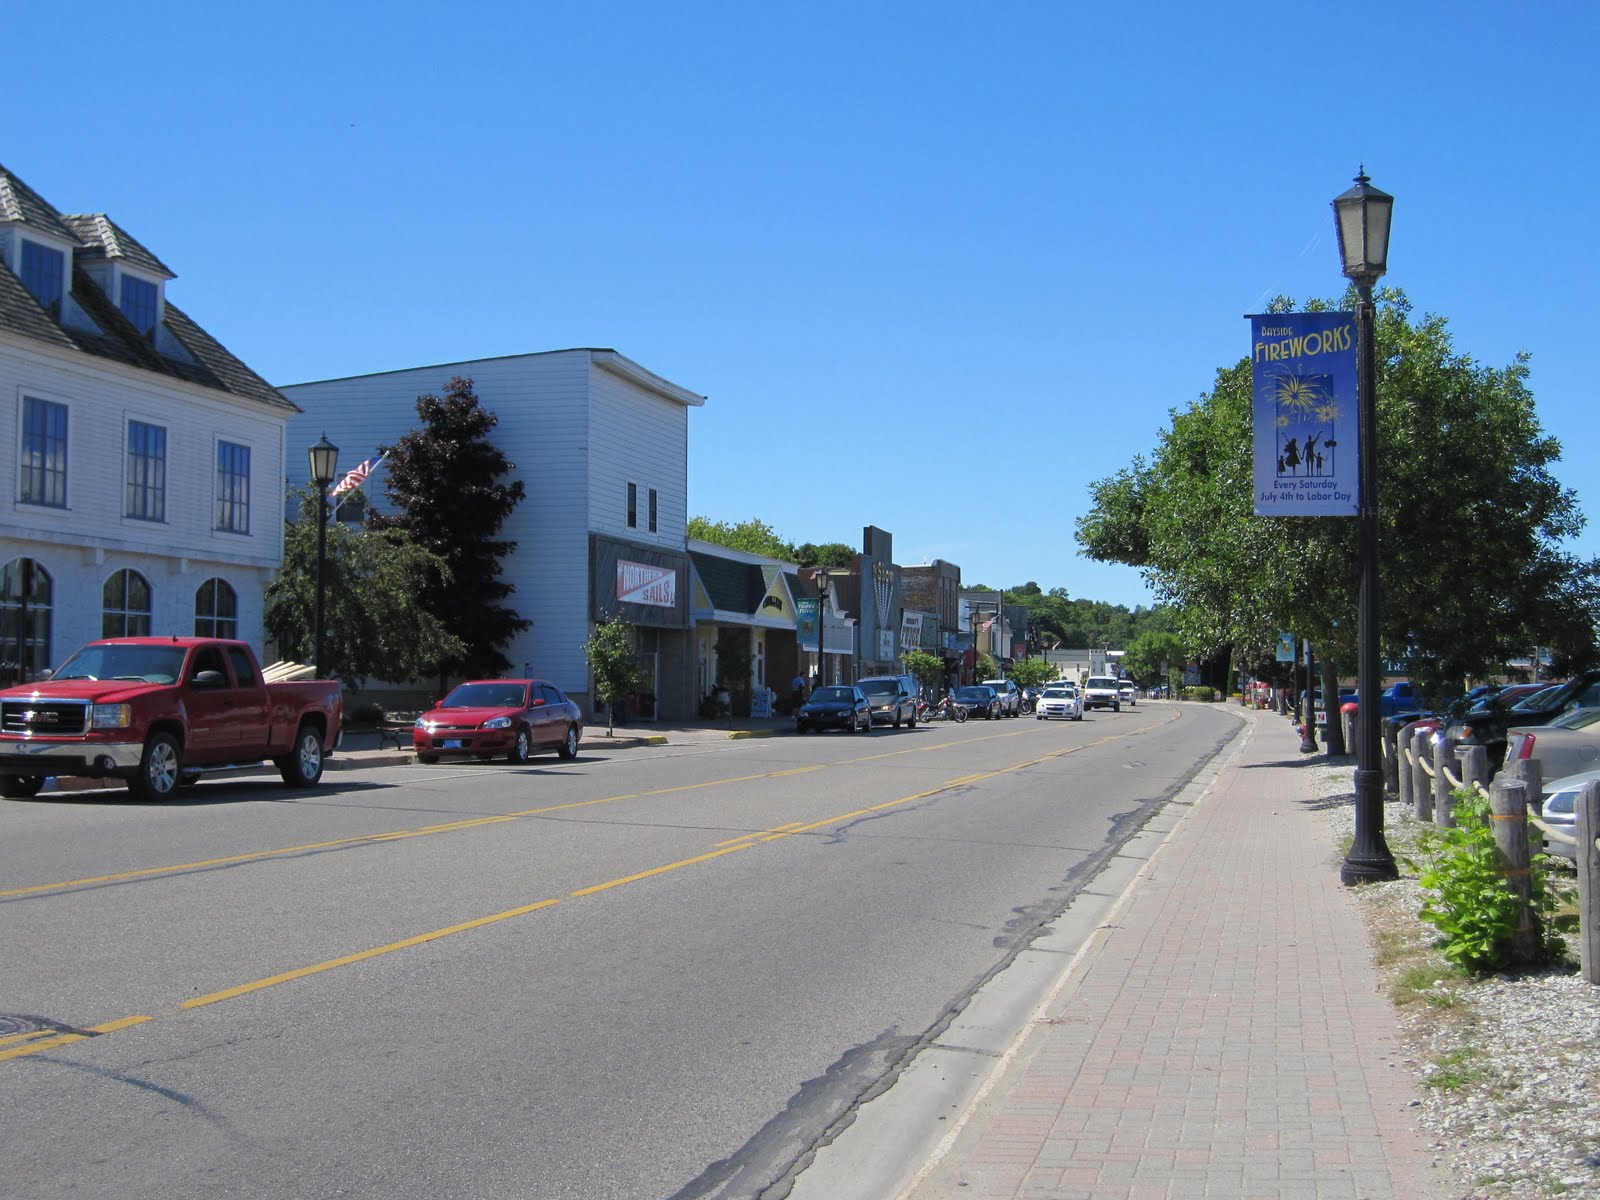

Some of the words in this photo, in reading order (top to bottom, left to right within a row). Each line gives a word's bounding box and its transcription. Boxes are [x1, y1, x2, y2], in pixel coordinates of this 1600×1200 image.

[1261, 326, 1294, 337] BAYSIDE
[1255, 324, 1351, 363] FIREWORKS
[1273, 480, 1297, 491] Every
[1299, 480, 1338, 490] Saturday
[1260, 492, 1278, 502] July
[1280, 491, 1294, 501] 4th
[1296, 492, 1305, 500] to
[1307, 491, 1332, 501] Labor
[1334, 491, 1352, 502] Day
[623, 564, 663, 591] NORTHERN
[642, 580, 670, 603] SAILS
